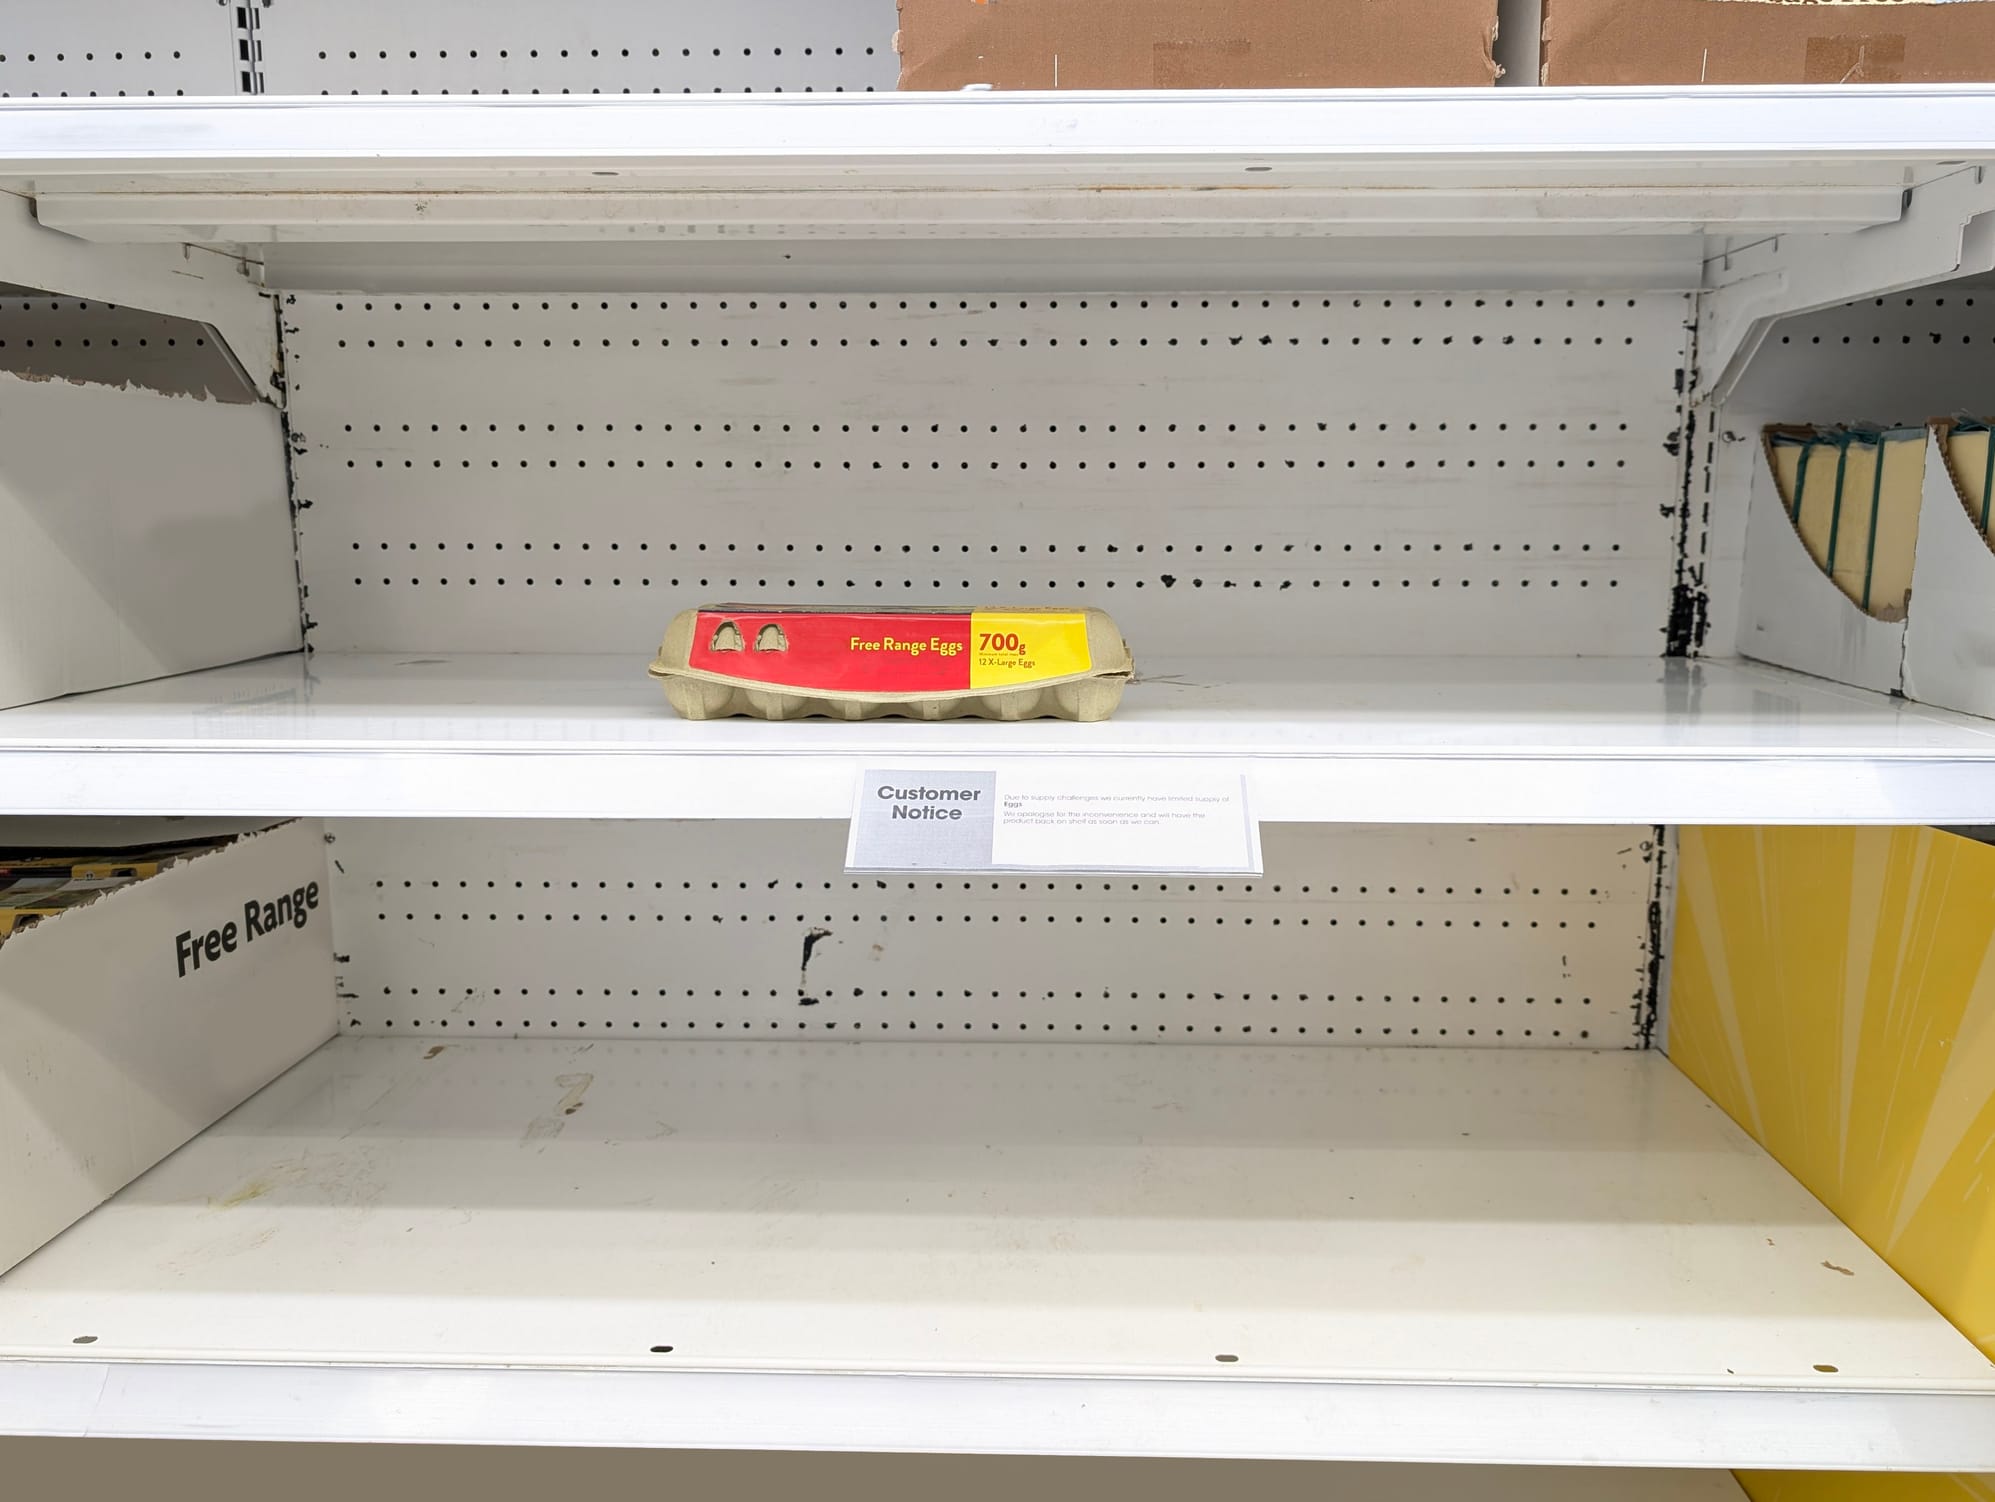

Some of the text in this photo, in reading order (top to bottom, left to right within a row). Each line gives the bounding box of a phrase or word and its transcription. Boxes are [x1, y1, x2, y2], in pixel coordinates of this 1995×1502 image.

[850, 637, 963, 656] Free Range Eggs
[979, 633, 1026, 656] 700g
[979, 658, 1036, 668] 12 X-Large Eggs
[877, 785, 981, 801] Customer
[1031, 794, 1055, 802] supply
[1057, 794, 1099, 802] challenges
[892, 804, 962, 820] Notice
[175, 881, 319, 978] Free Range
